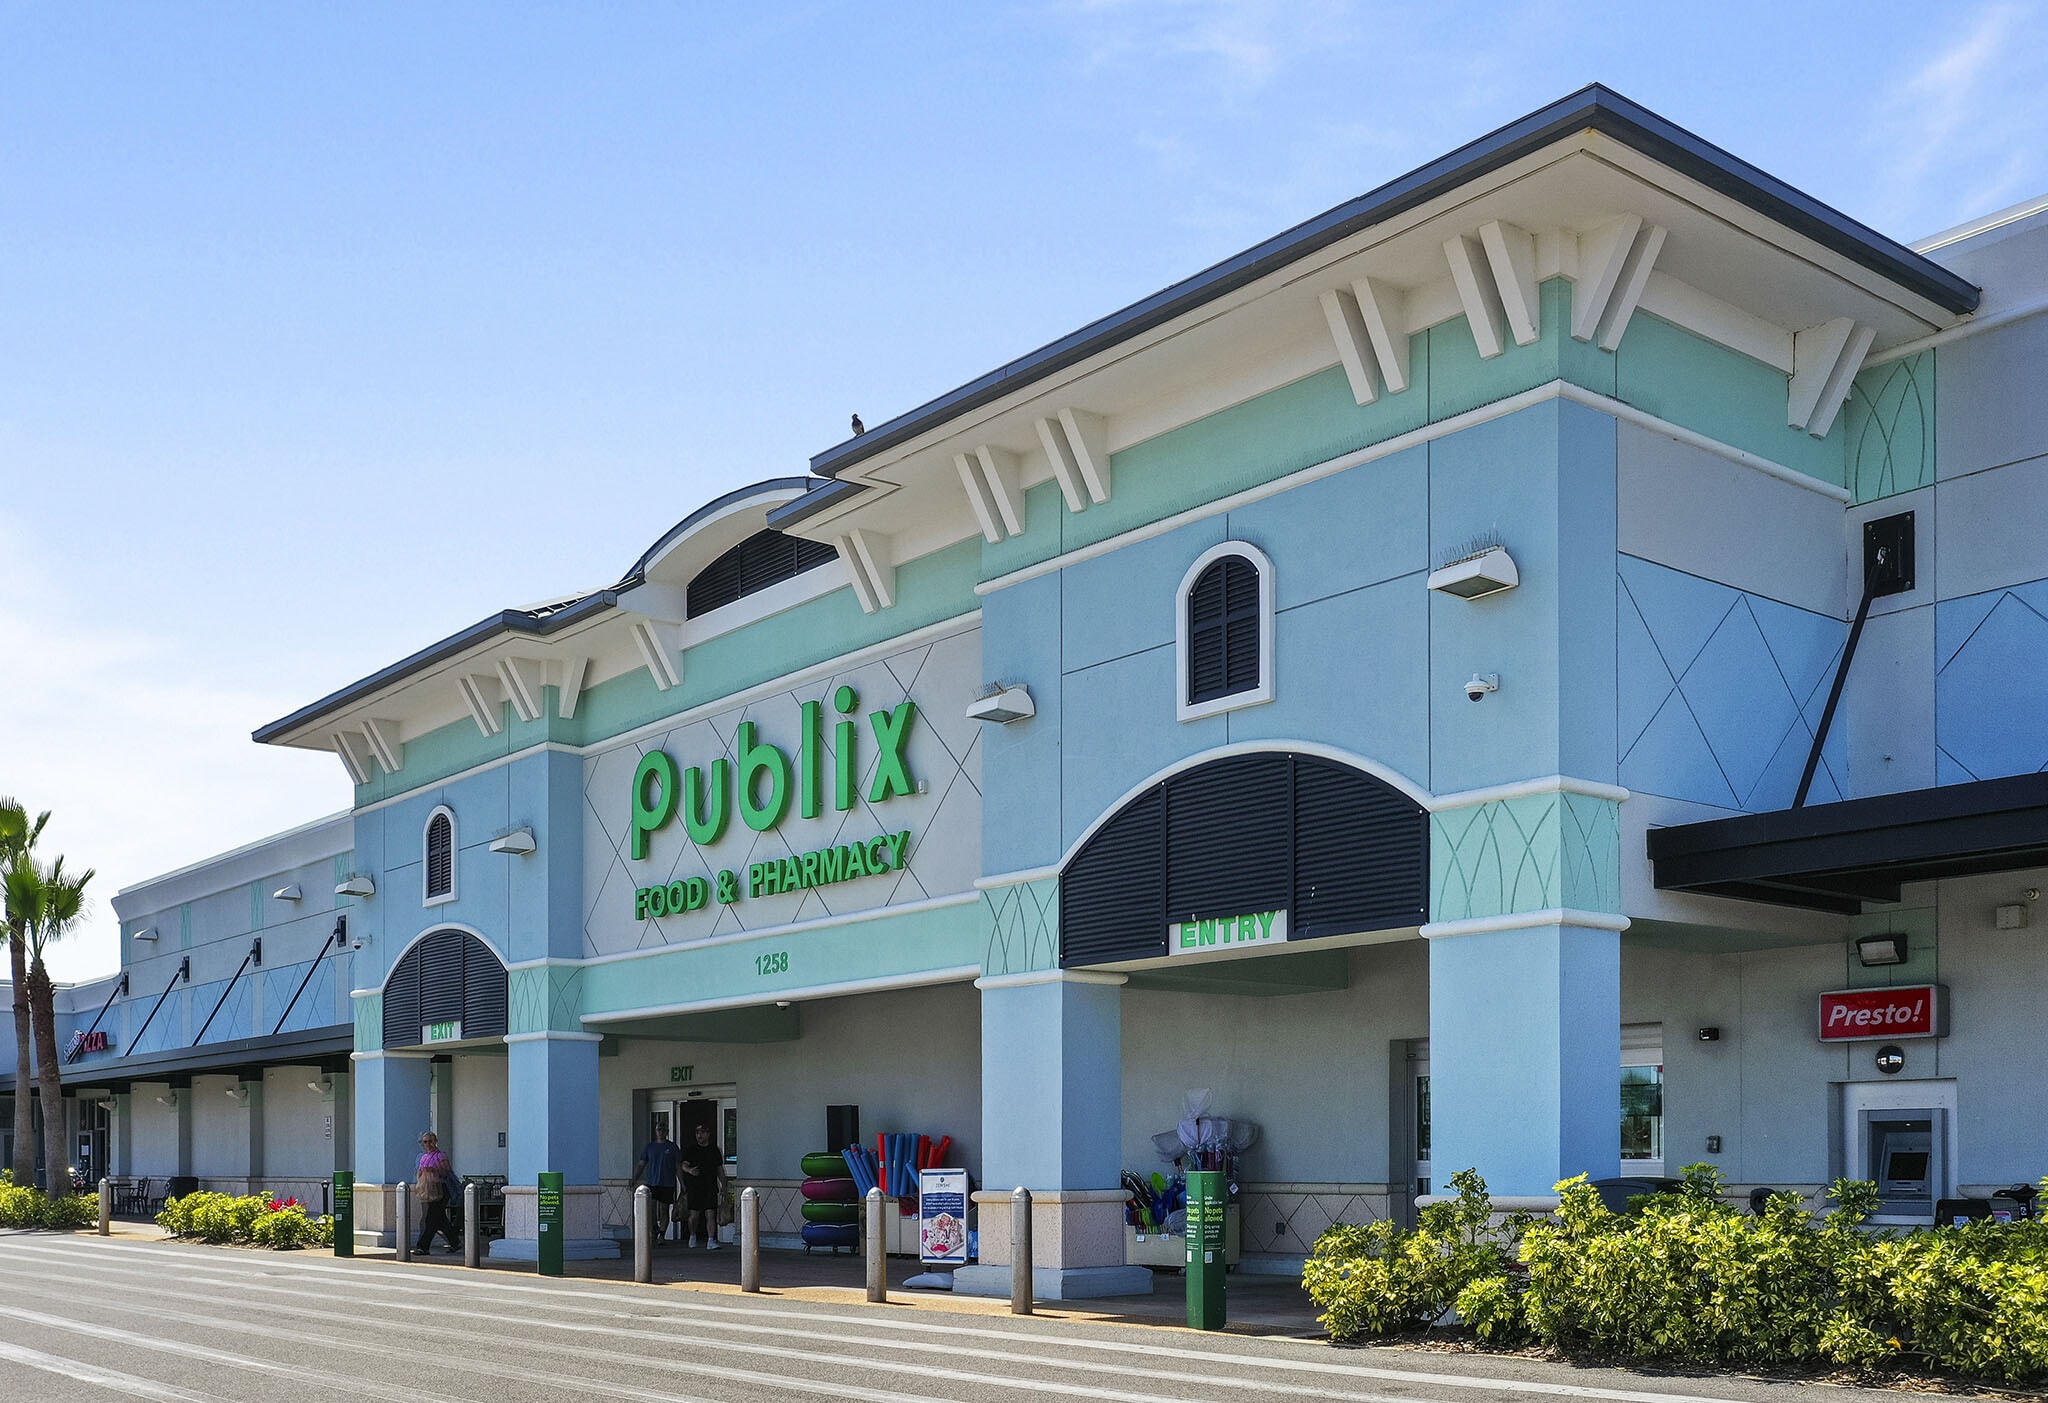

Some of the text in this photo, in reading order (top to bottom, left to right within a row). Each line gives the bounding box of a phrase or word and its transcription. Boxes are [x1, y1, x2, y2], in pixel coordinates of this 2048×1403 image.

[631, 686, 917, 861] Publix
[635, 830, 911, 920] FOOD & PHARMACY
[1181, 911, 1276, 948] ENTRY
[755, 951, 788, 975] 1258
[1828, 1000, 1923, 1027] Presto!
[431, 1022, 454, 1040] EXIT
[671, 1065, 694, 1081] EXIT
[1212, 1207, 1223, 1215] pets
